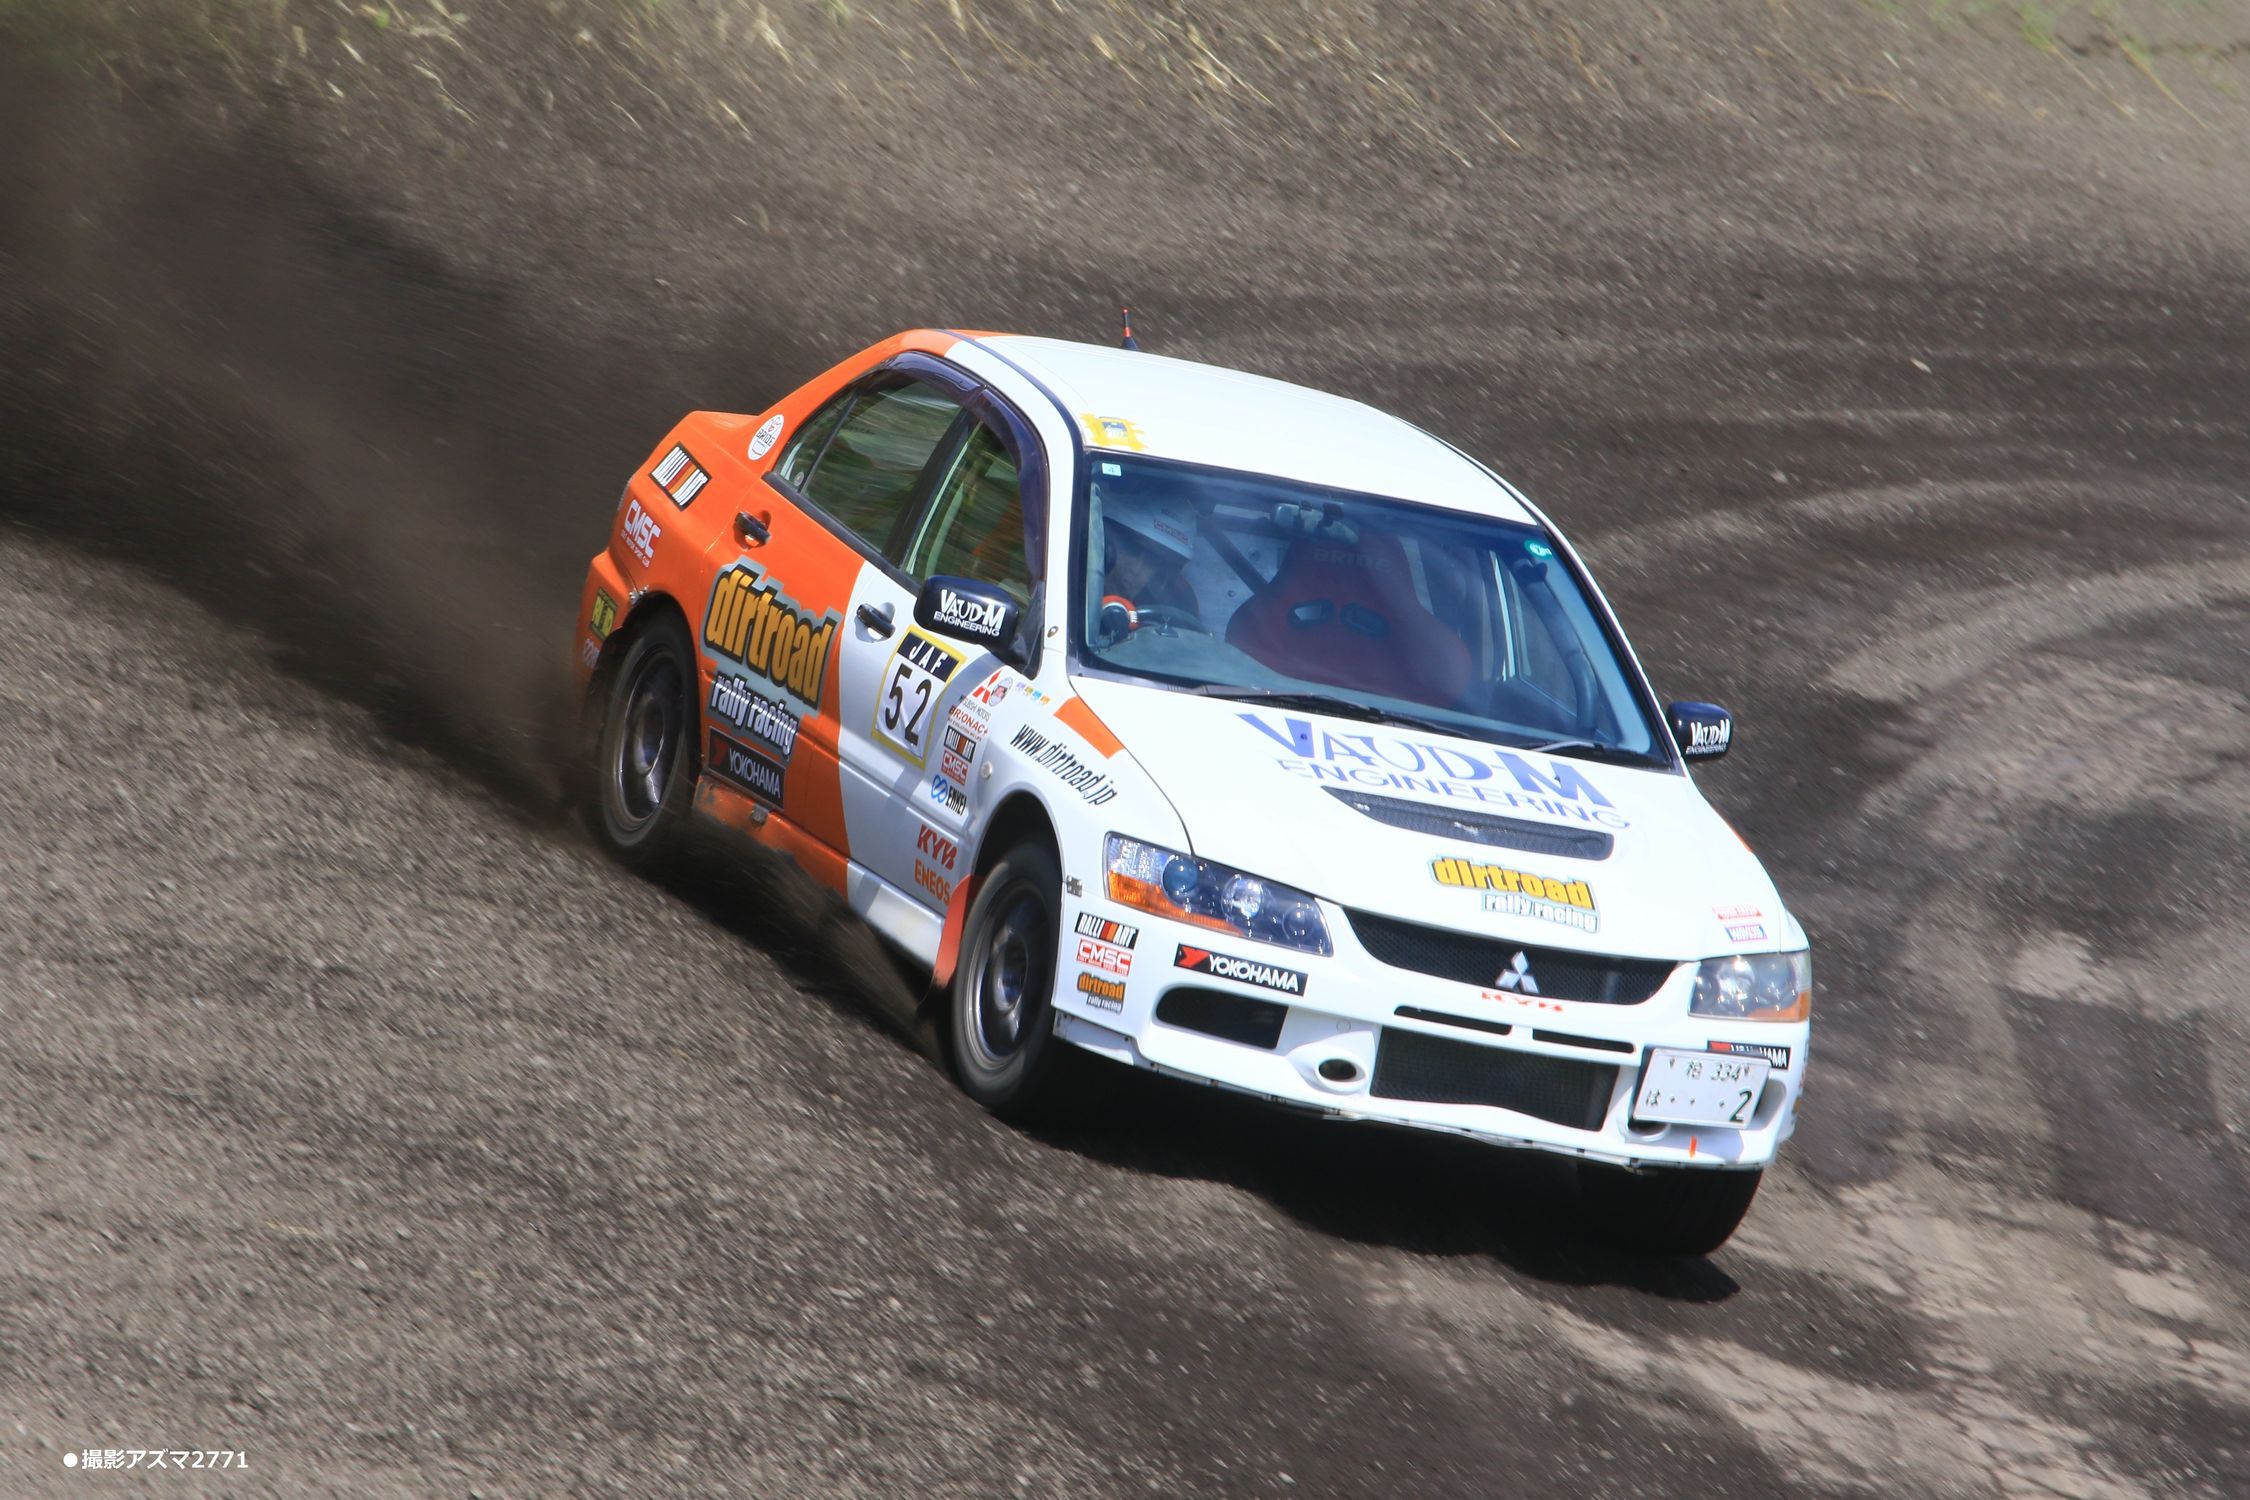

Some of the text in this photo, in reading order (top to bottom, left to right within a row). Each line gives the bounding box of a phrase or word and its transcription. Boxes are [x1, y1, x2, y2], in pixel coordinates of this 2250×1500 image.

[623, 499, 661, 559] CMSC
[704, 565, 836, 706] dirtroad
[933, 611, 1001, 637] ENGINEERING
[908, 639, 949, 673] JAF
[711, 675, 798, 756] rally racing
[885, 662, 933, 747] 52
[729, 748, 781, 799] YOKOHAMA
[943, 752, 969, 778] CMSC
[1009, 723, 1118, 807] www.dirtroad.jp
[1275, 759, 1632, 829] ENGINEERING
[917, 823, 958, 871] KYB
[914, 858, 951, 904] ENEOS
[1432, 856, 1597, 912] dirtroad
[1484, 892, 1598, 932] rally racing
[1079, 940, 1132, 969] CMSC
[1208, 953, 1299, 993] YOKOHAMA
[1077, 971, 1125, 1002] dirtroad
[1710, 1062, 1741, 1081] 334
